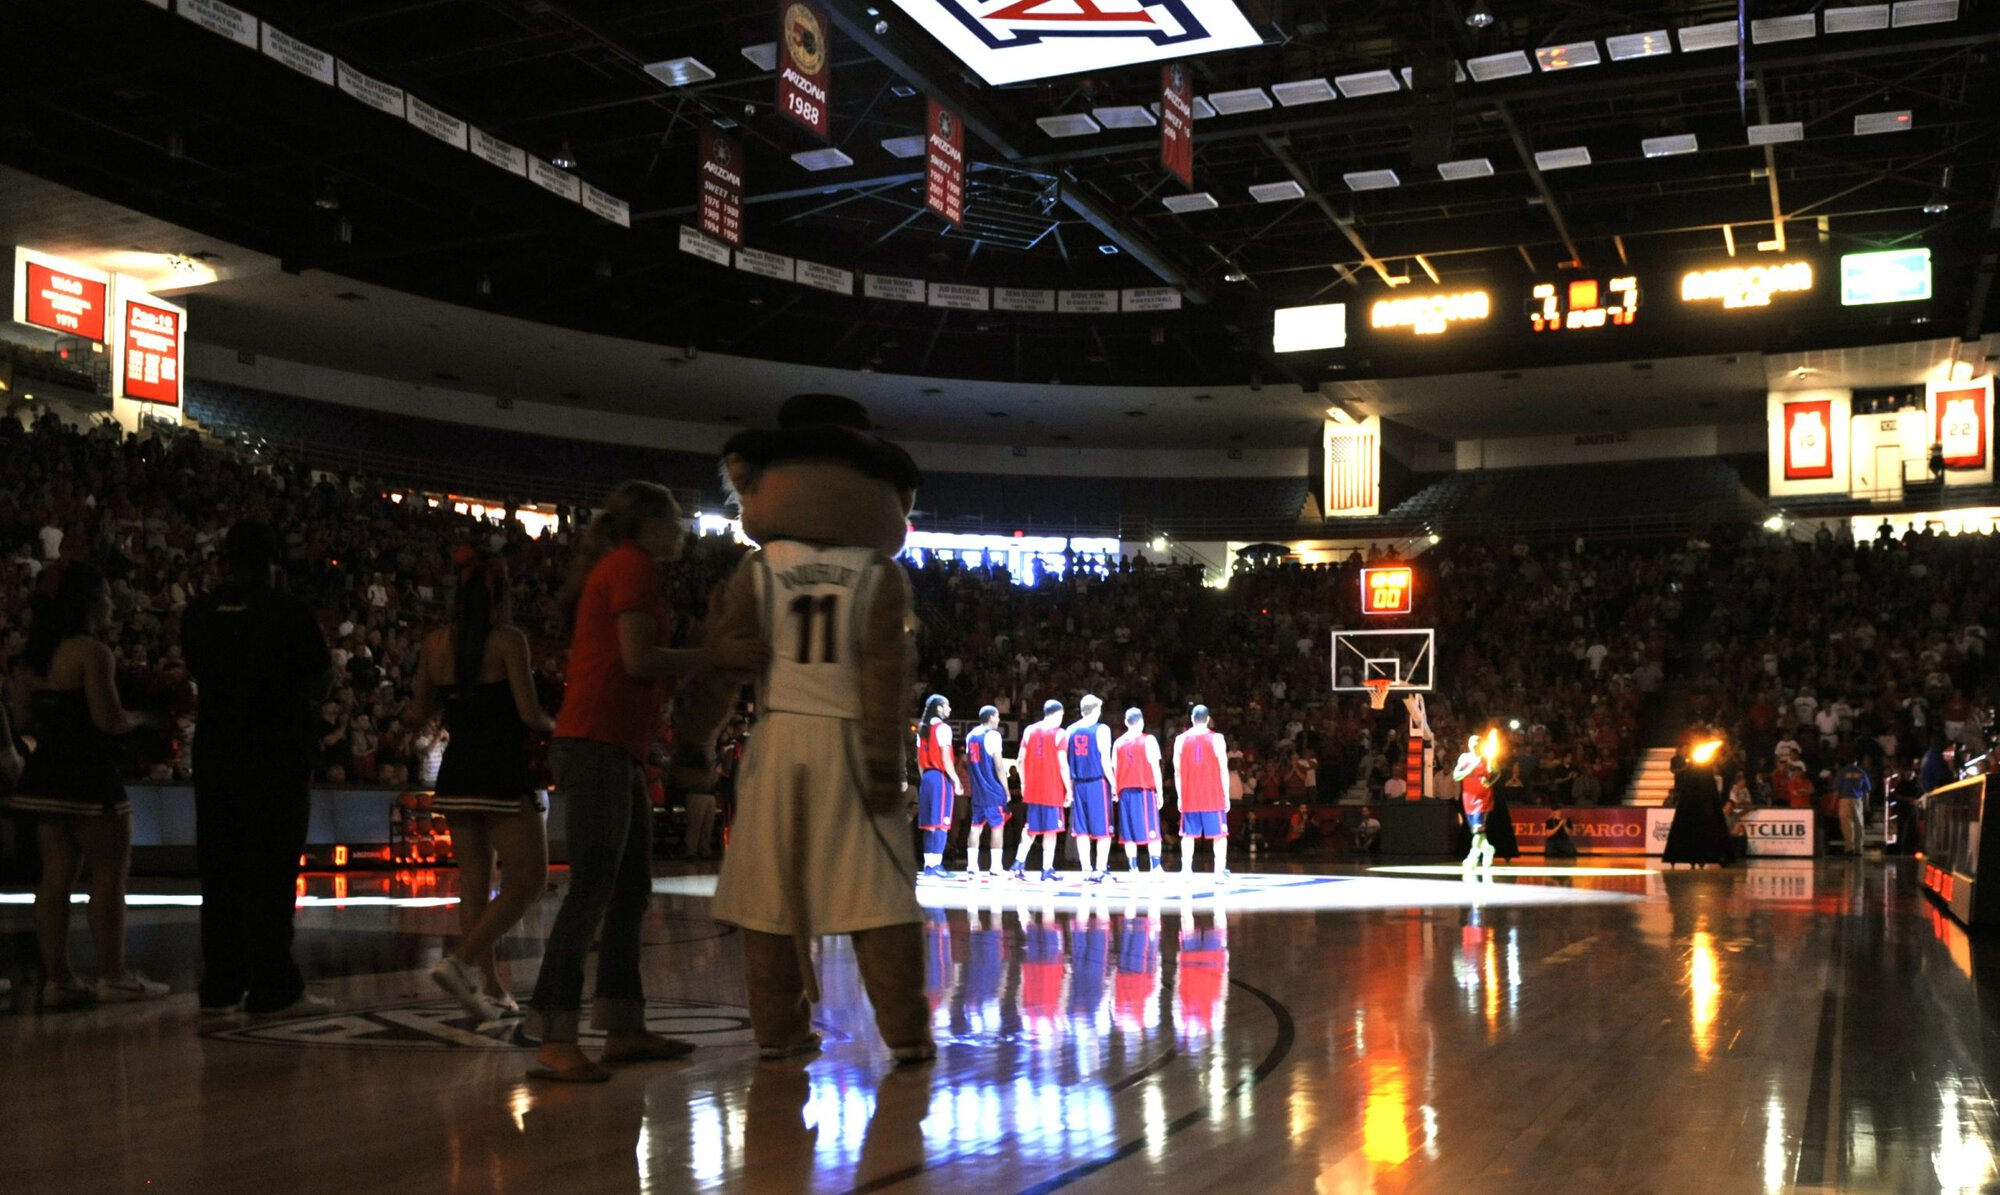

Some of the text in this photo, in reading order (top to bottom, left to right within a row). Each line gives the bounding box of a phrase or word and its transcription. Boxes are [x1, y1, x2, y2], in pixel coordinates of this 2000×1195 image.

[782, 68, 826, 104] ARIZONA
[788, 93, 819, 126] 1988
[1164, 87, 1191, 119] ARIZONA
[930, 133, 961, 163] ARIZONA
[704, 160, 741, 187] ARIZONA
[930, 154, 951, 173] SWEET
[704, 180, 739, 205] SWEET 16
[1949, 422, 1971, 436] 22
[790, 594, 838, 665] 11
[1569, 822, 1642, 838] FARGO
